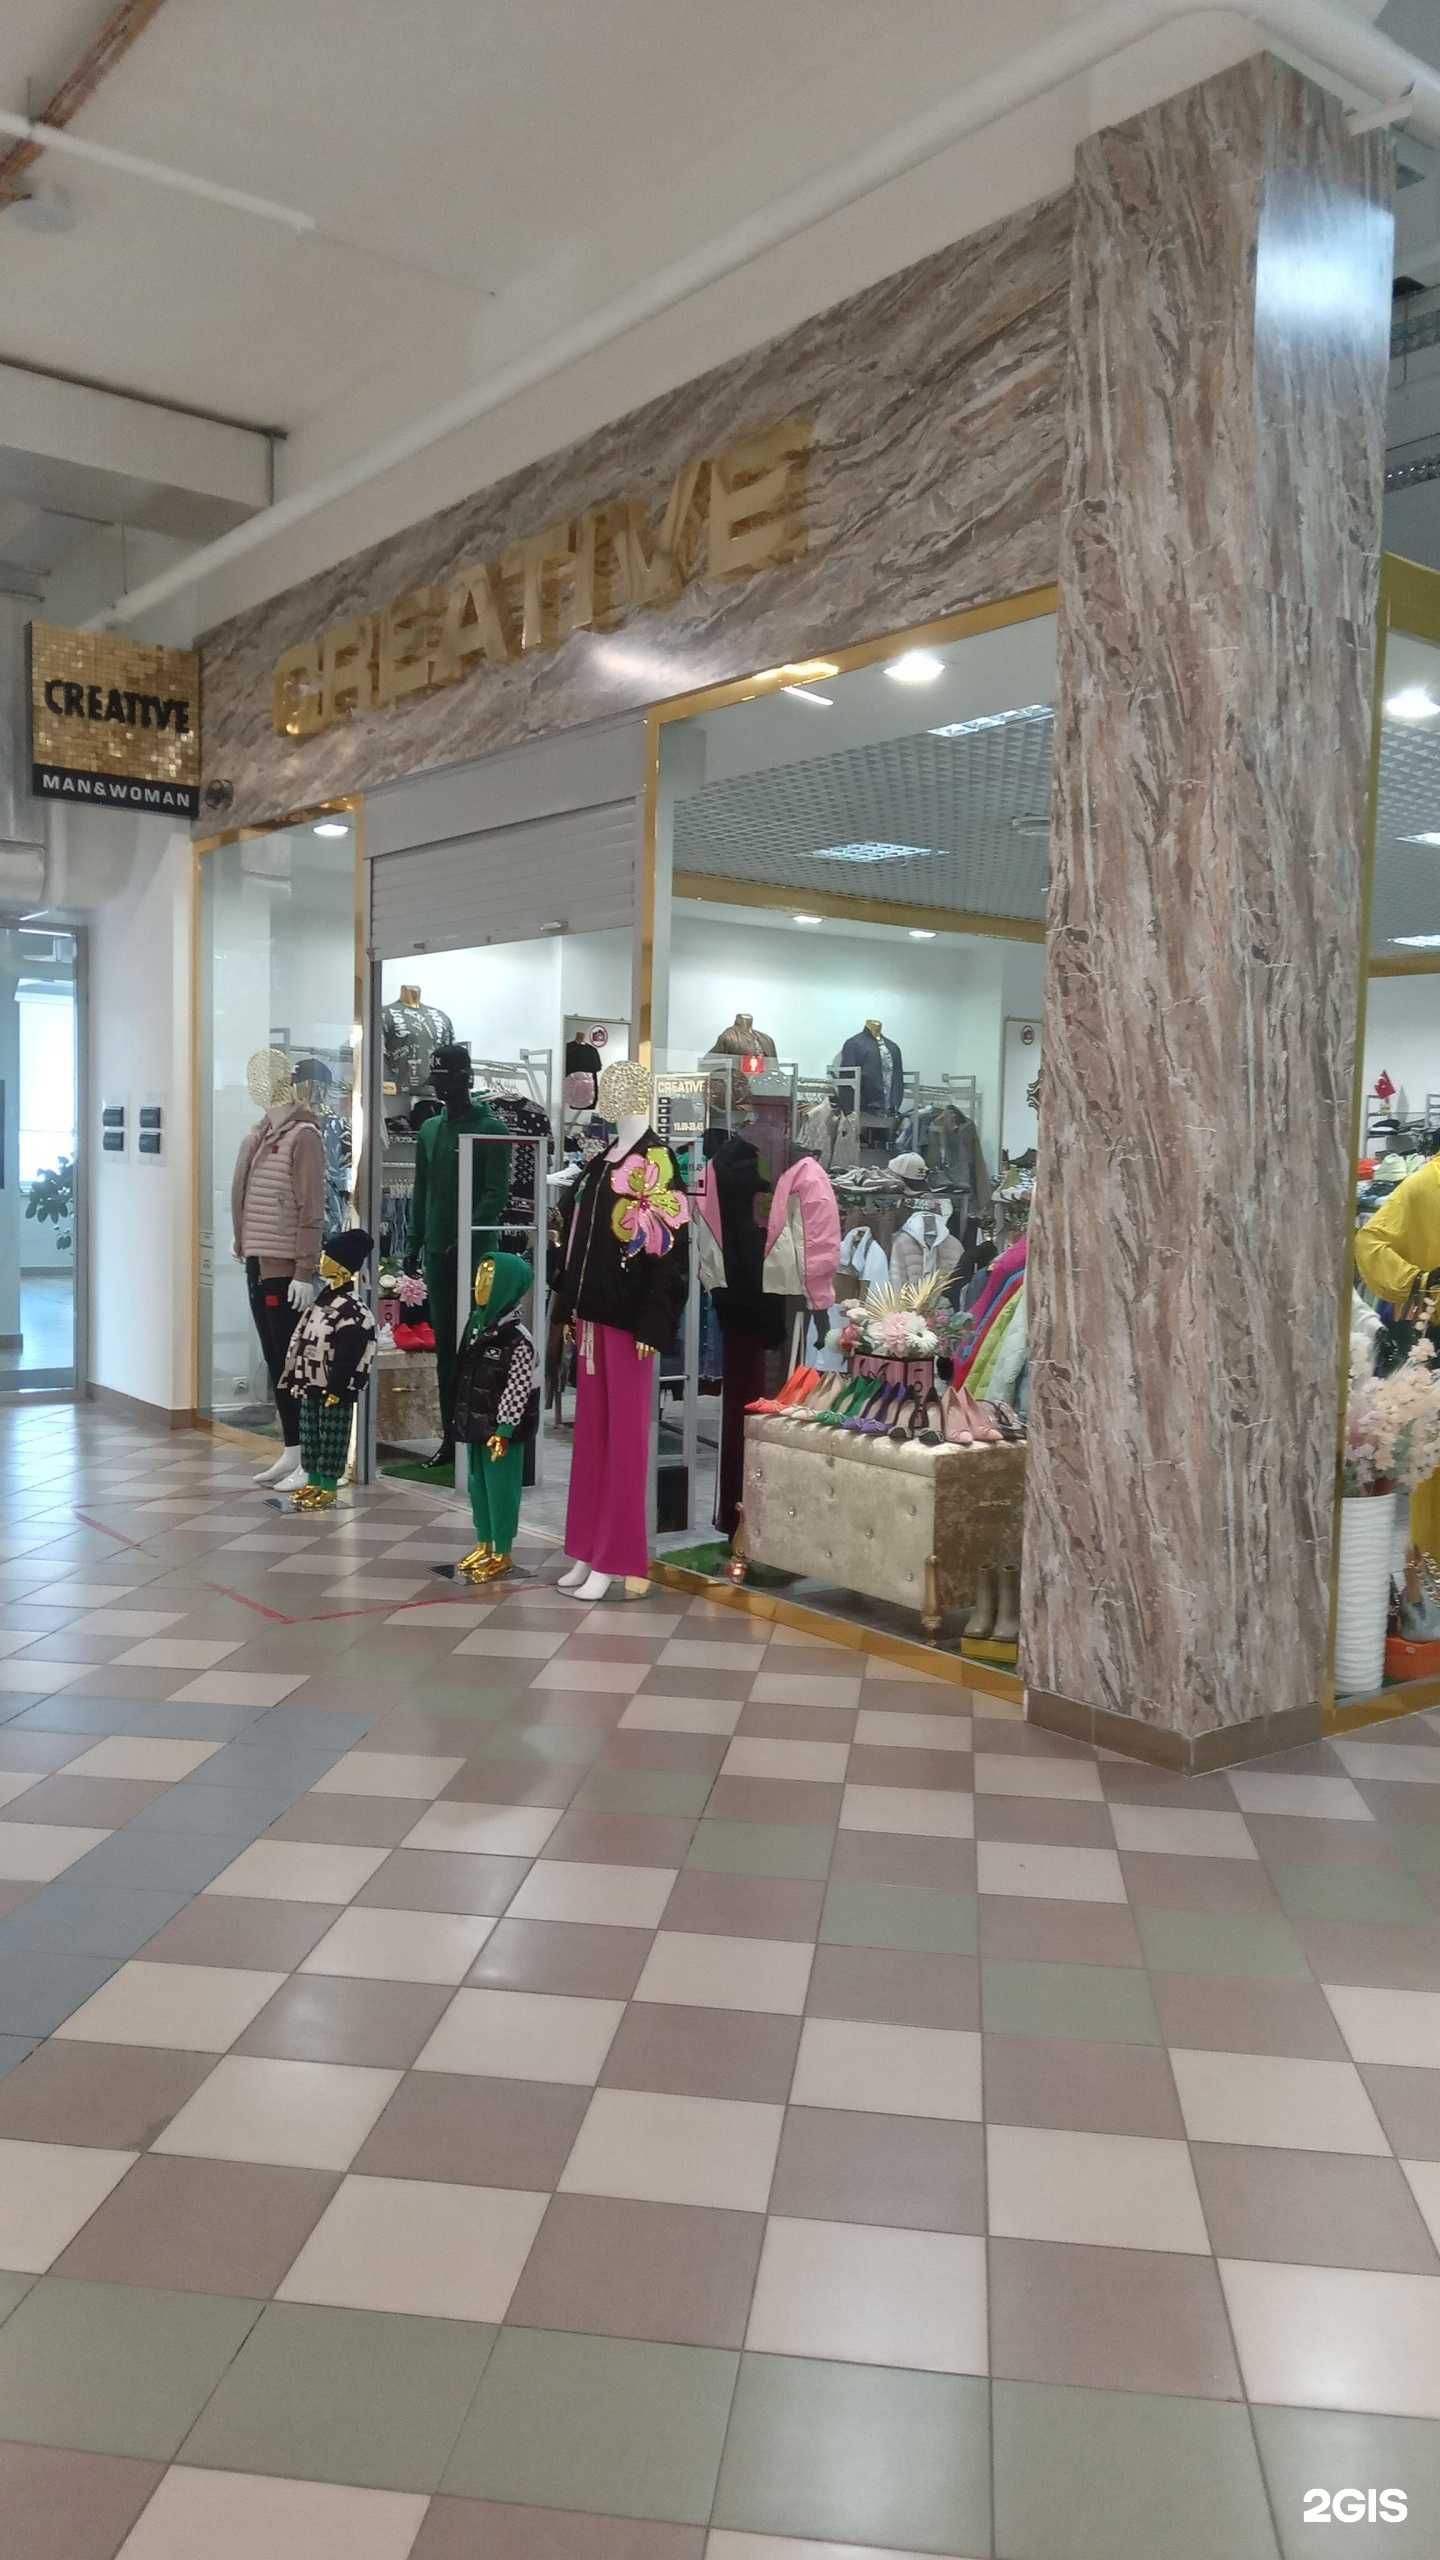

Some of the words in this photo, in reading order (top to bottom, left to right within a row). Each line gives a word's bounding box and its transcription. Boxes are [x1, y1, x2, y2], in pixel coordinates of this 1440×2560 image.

[272, 416, 814, 737] CREATIVE
[44, 679, 190, 733] CREATIVE
[42, 774, 190, 807] MAN&WOMAN
